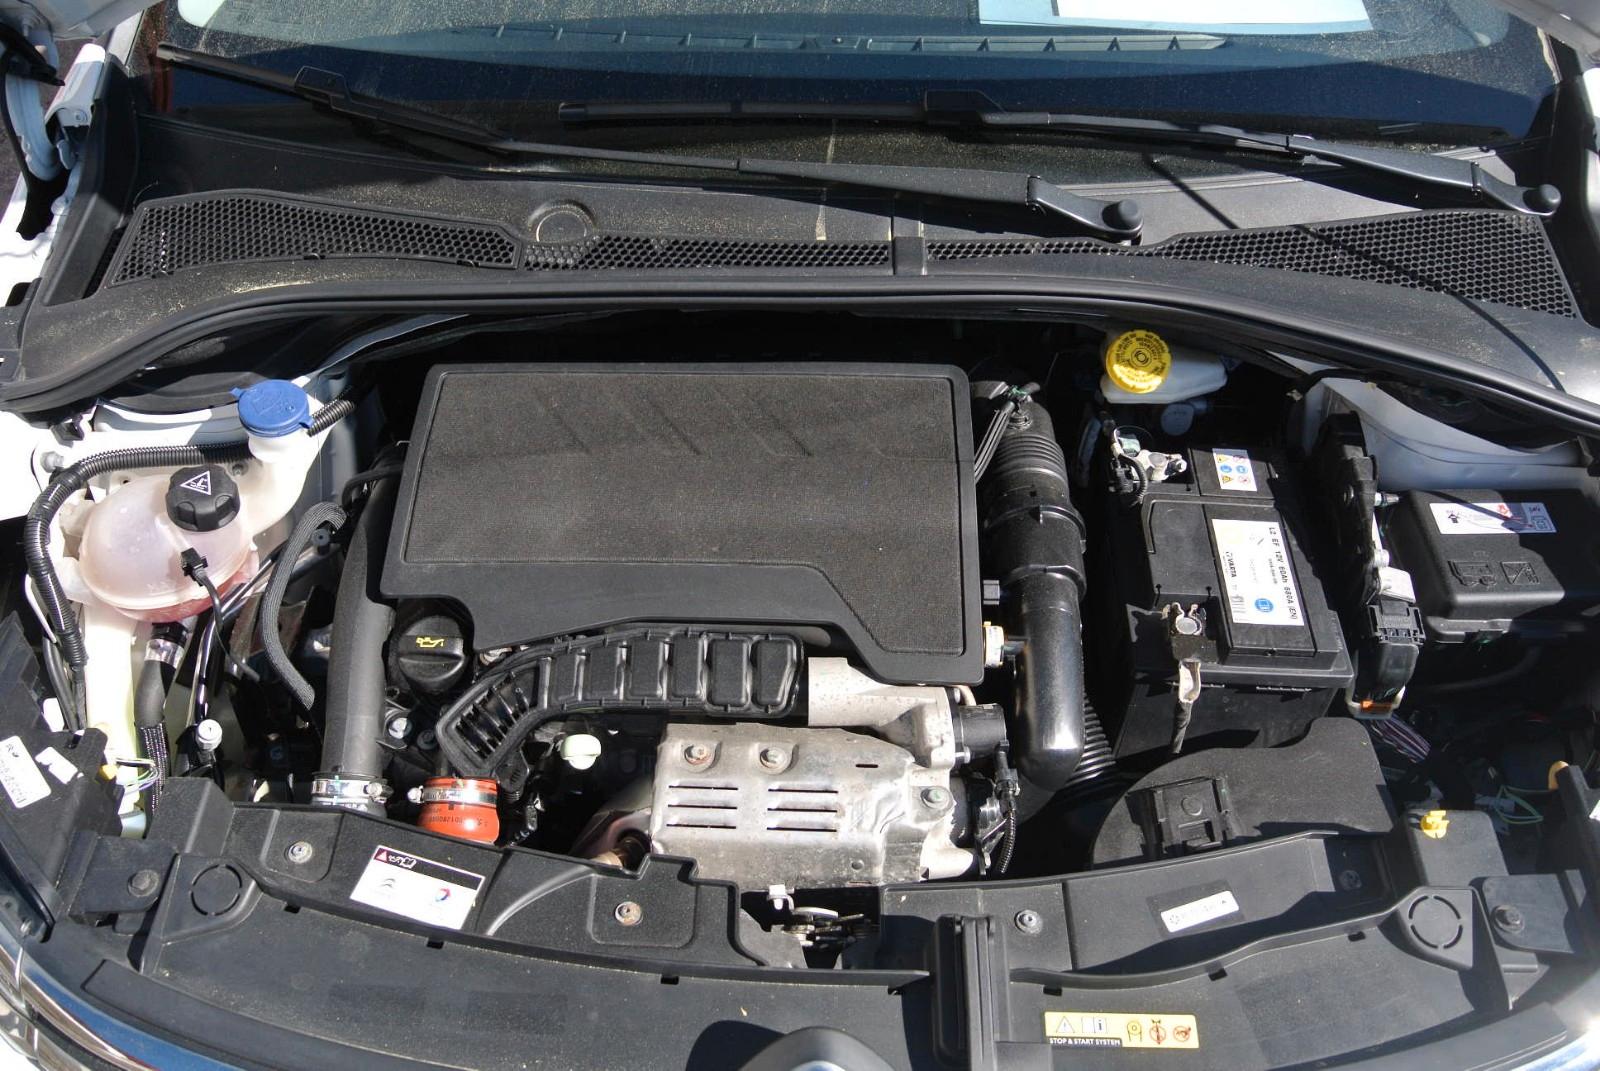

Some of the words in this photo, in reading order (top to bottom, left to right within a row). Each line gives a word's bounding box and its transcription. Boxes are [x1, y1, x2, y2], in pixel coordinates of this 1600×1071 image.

[1269, 526, 1276, 534] L2
[1272, 538, 1280, 547] EF
[1275, 551, 1284, 563] 12V
[1228, 558, 1237, 578] VARTA
[1278, 566, 1288, 583] 60Ah
[1288, 604, 1298, 620] (EN)
